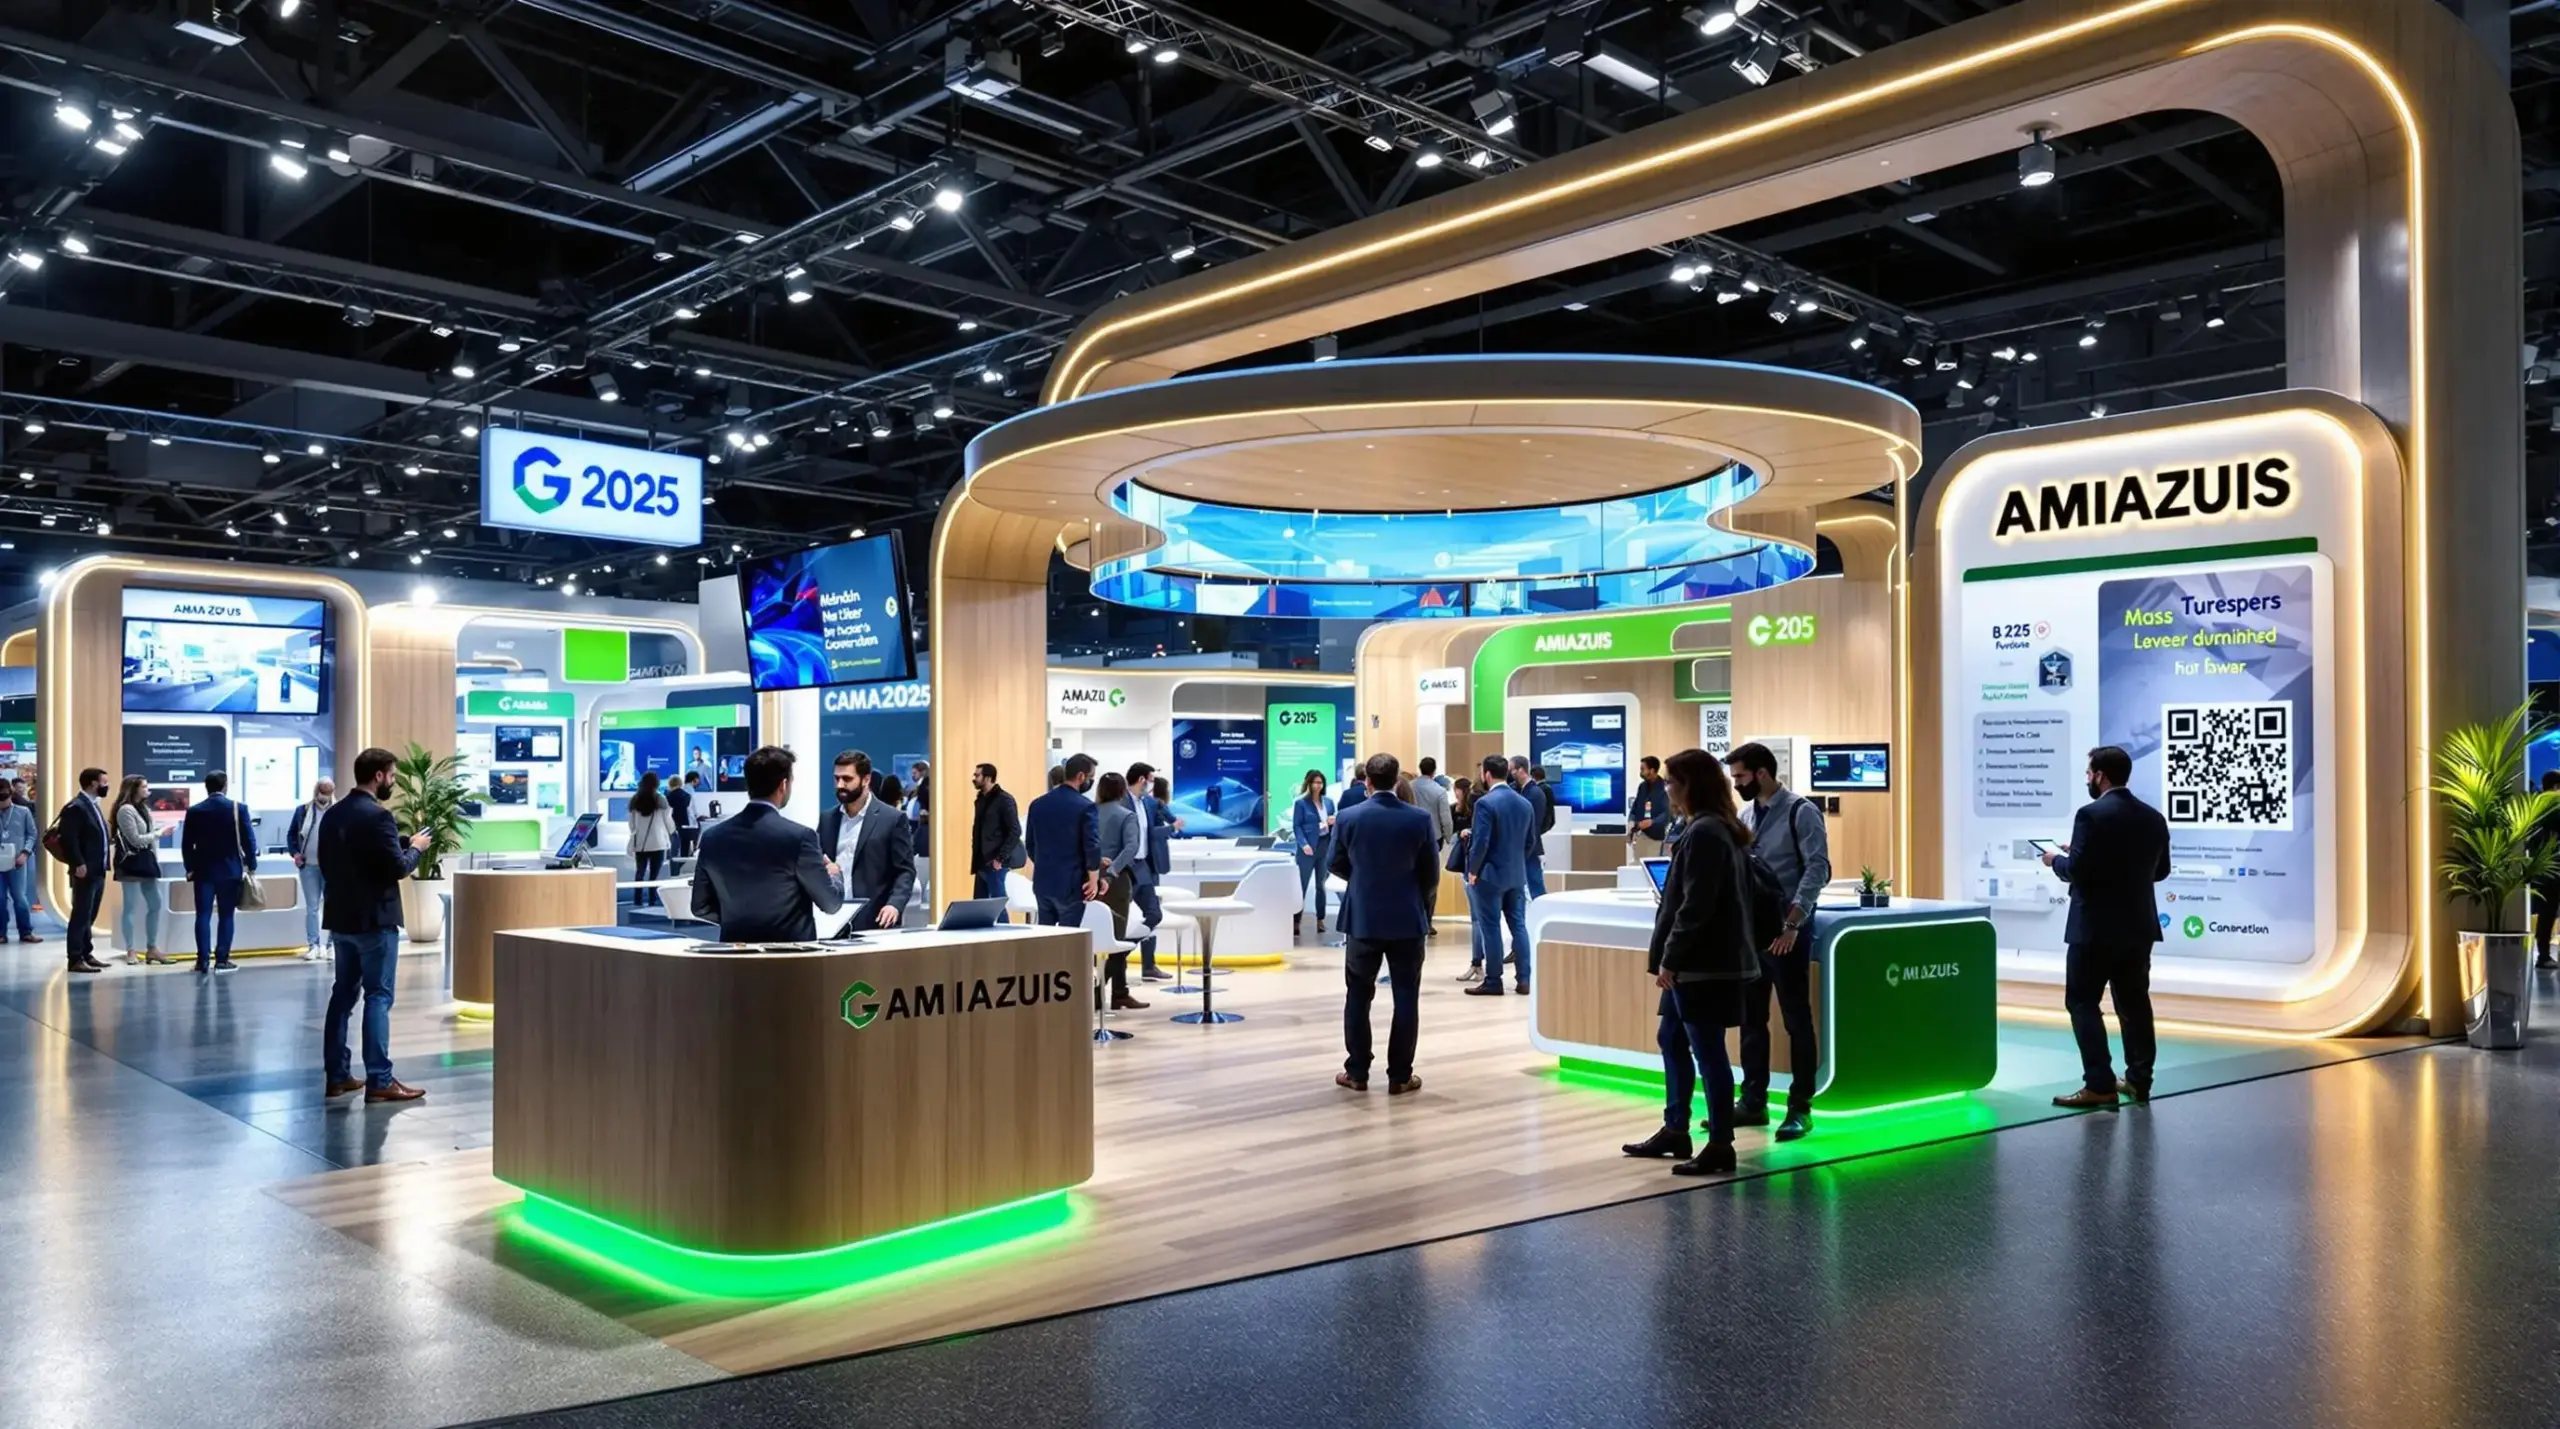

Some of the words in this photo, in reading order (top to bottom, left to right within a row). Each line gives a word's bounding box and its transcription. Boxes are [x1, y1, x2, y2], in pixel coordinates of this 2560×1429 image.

[513, 446, 571, 514] G
[582, 465, 680, 517] 2025
[1995, 457, 2291, 537] AMIAZUIS
[1775, 615, 1814, 639] 205
[2124, 608, 2174, 627] Mass
[2180, 595, 2282, 617] Turespers
[1992, 626, 2002, 639] B
[2004, 623, 2031, 638] 225
